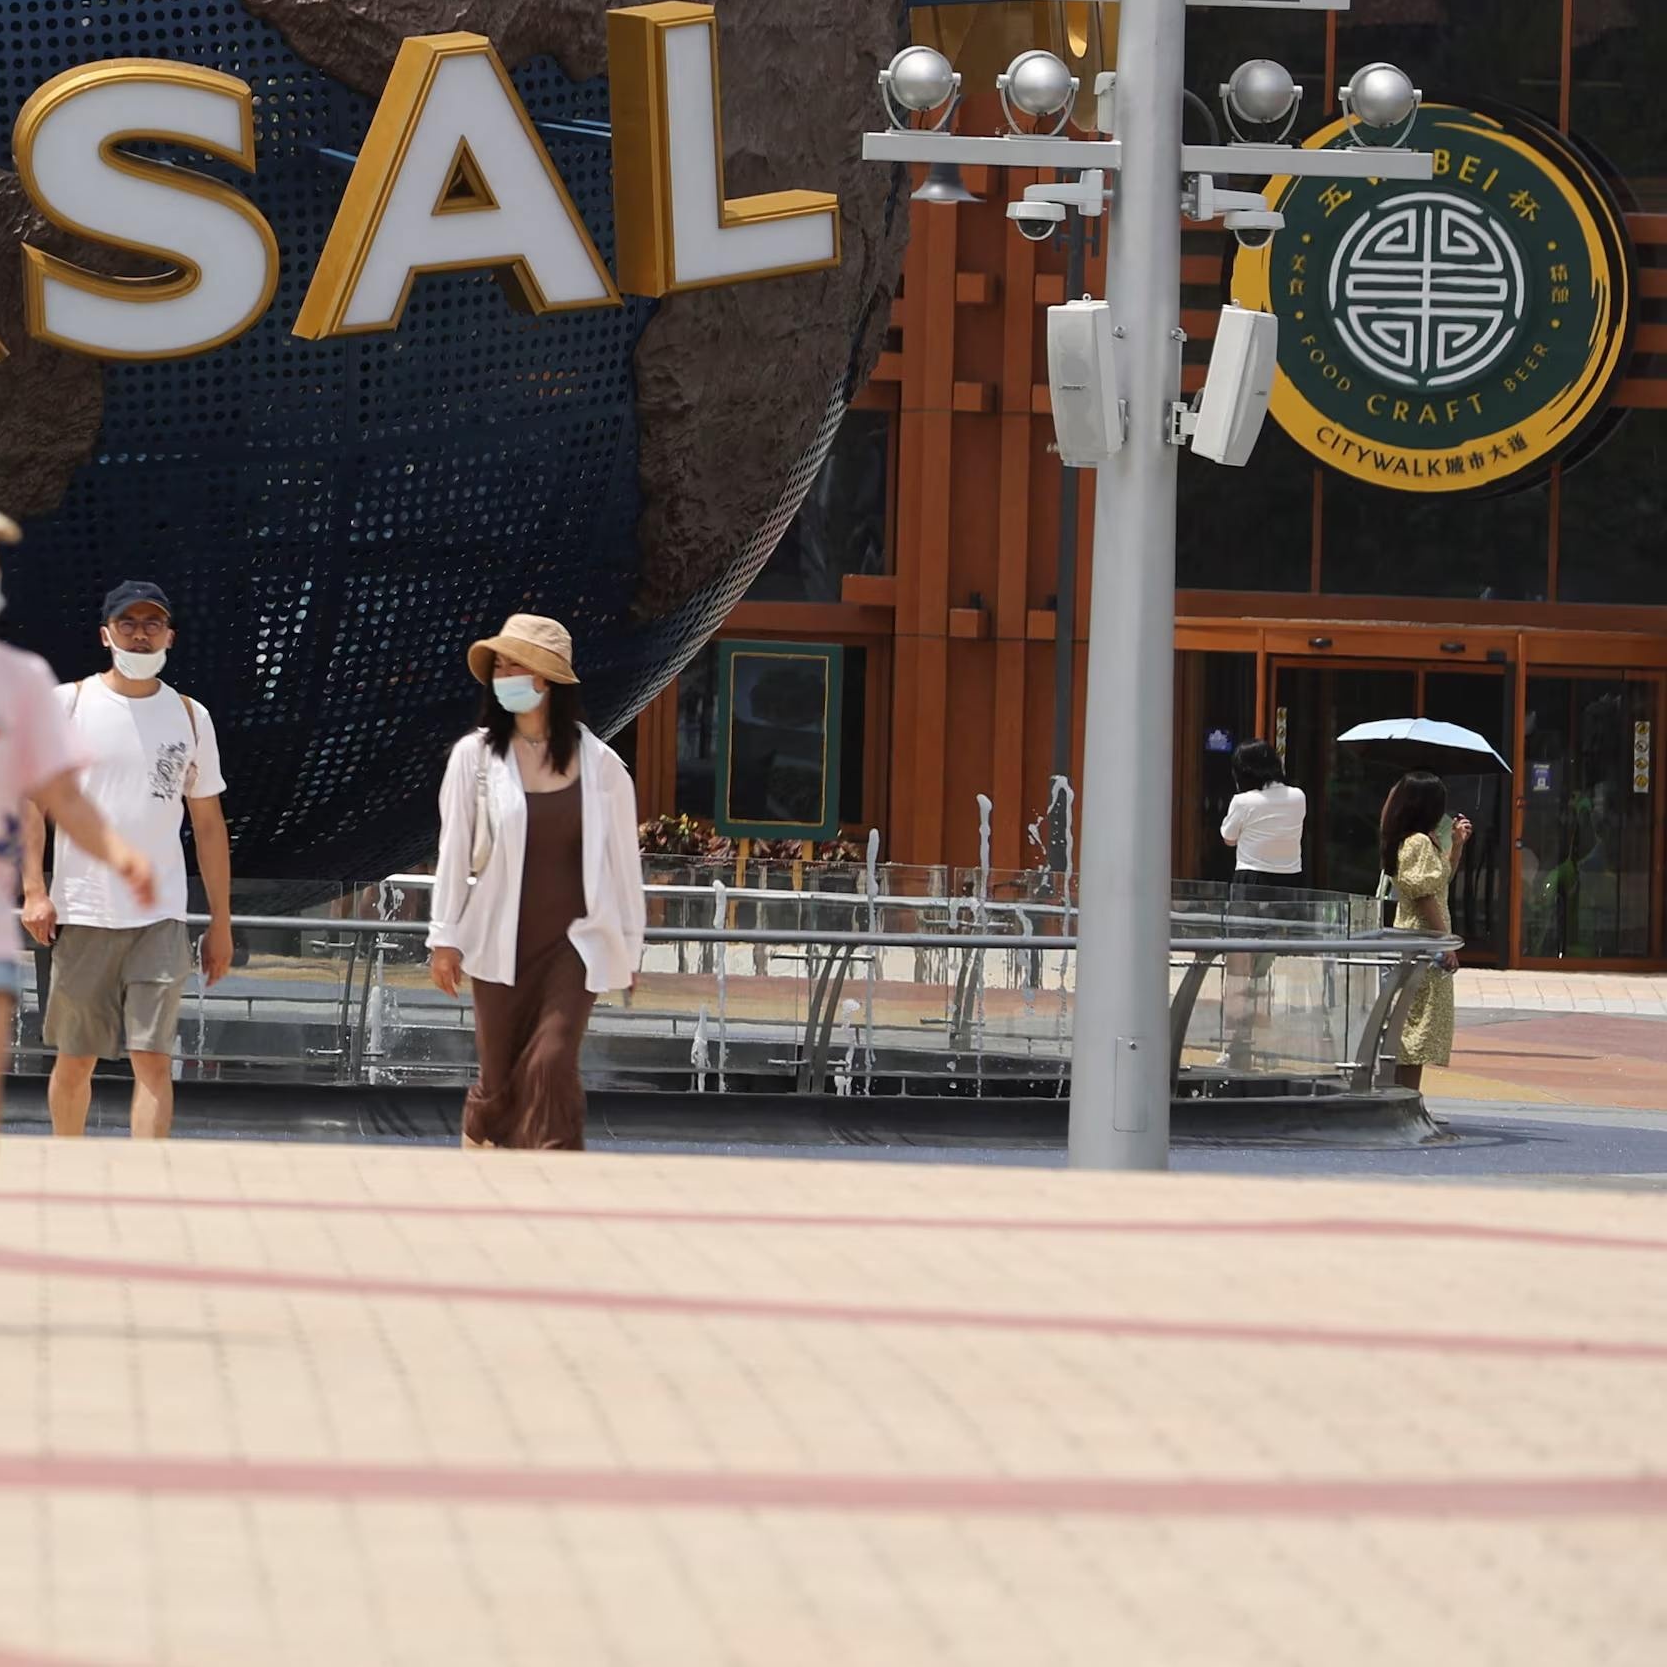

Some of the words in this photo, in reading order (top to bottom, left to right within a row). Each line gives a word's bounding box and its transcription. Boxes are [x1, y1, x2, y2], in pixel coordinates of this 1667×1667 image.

[1508, 188, 1542, 222] 杯
[1300, 334, 1352, 393] FOOD
[1503, 342, 1549, 393] BEER
[1367, 393, 1484, 425] CRAFT
